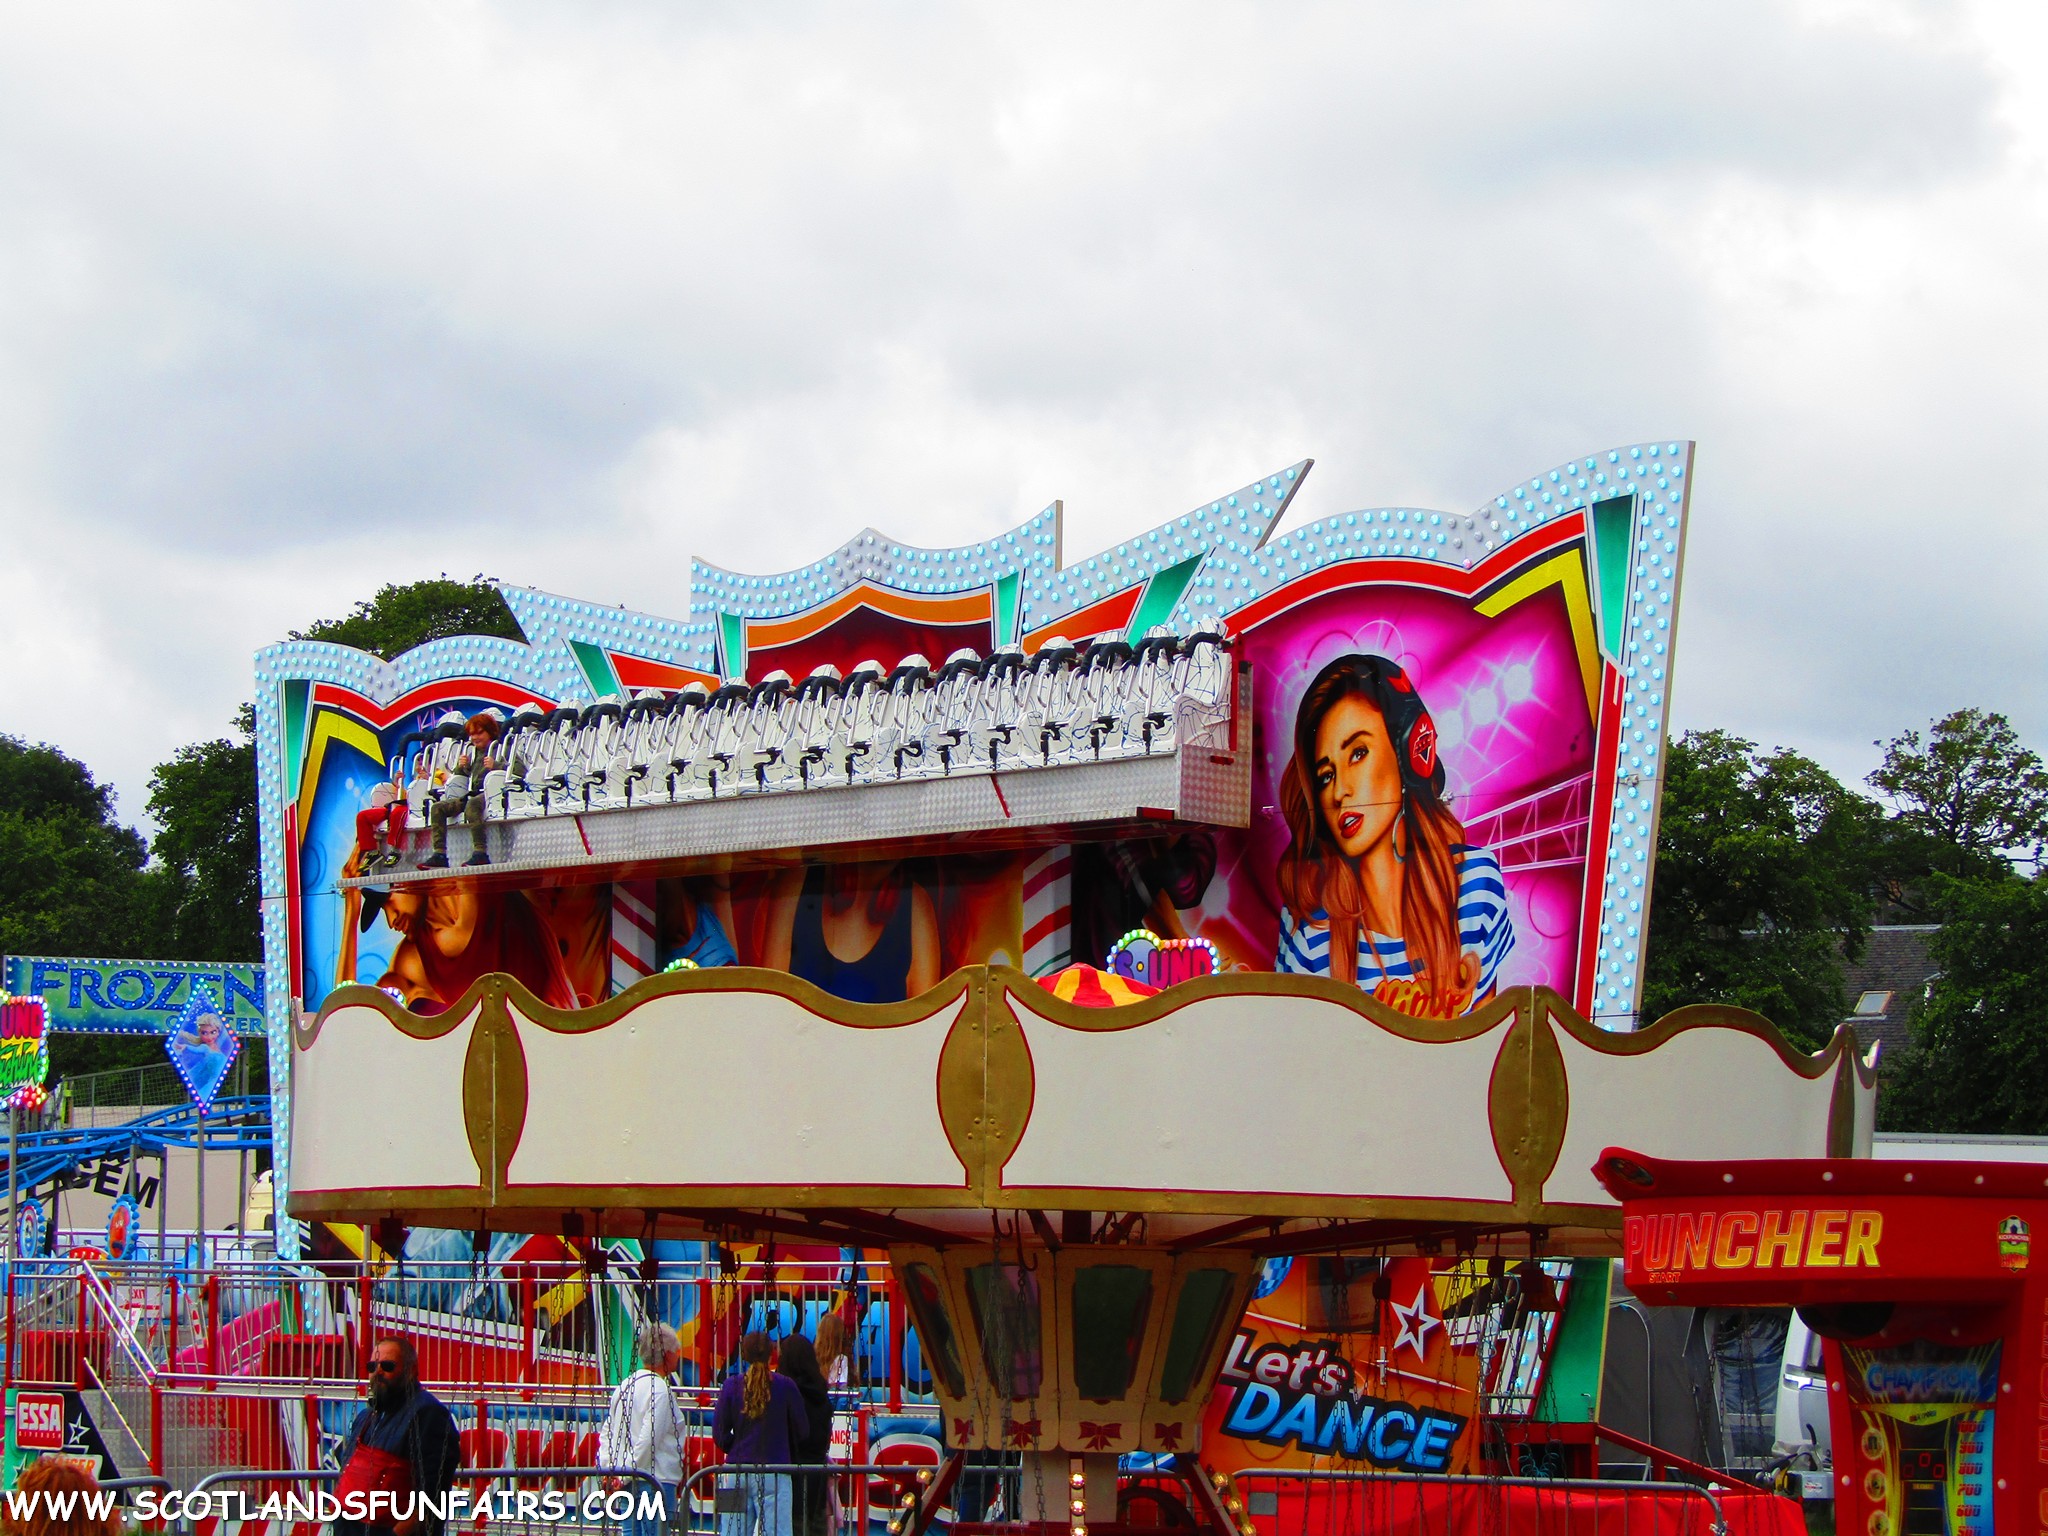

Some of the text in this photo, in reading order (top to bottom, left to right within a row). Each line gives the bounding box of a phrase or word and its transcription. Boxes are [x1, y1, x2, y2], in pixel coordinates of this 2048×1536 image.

[0, 1003, 44, 1039] UND
[1625, 1210, 1884, 1273] PUNCHER
[1648, 1271, 1682, 1284] START
[1221, 1333, 1348, 1397] Let's
[1867, 1362, 1979, 1394] CHAMPION
[18, 1402, 62, 1432] ESSA
[1227, 1381, 1458, 1468] DANCE
